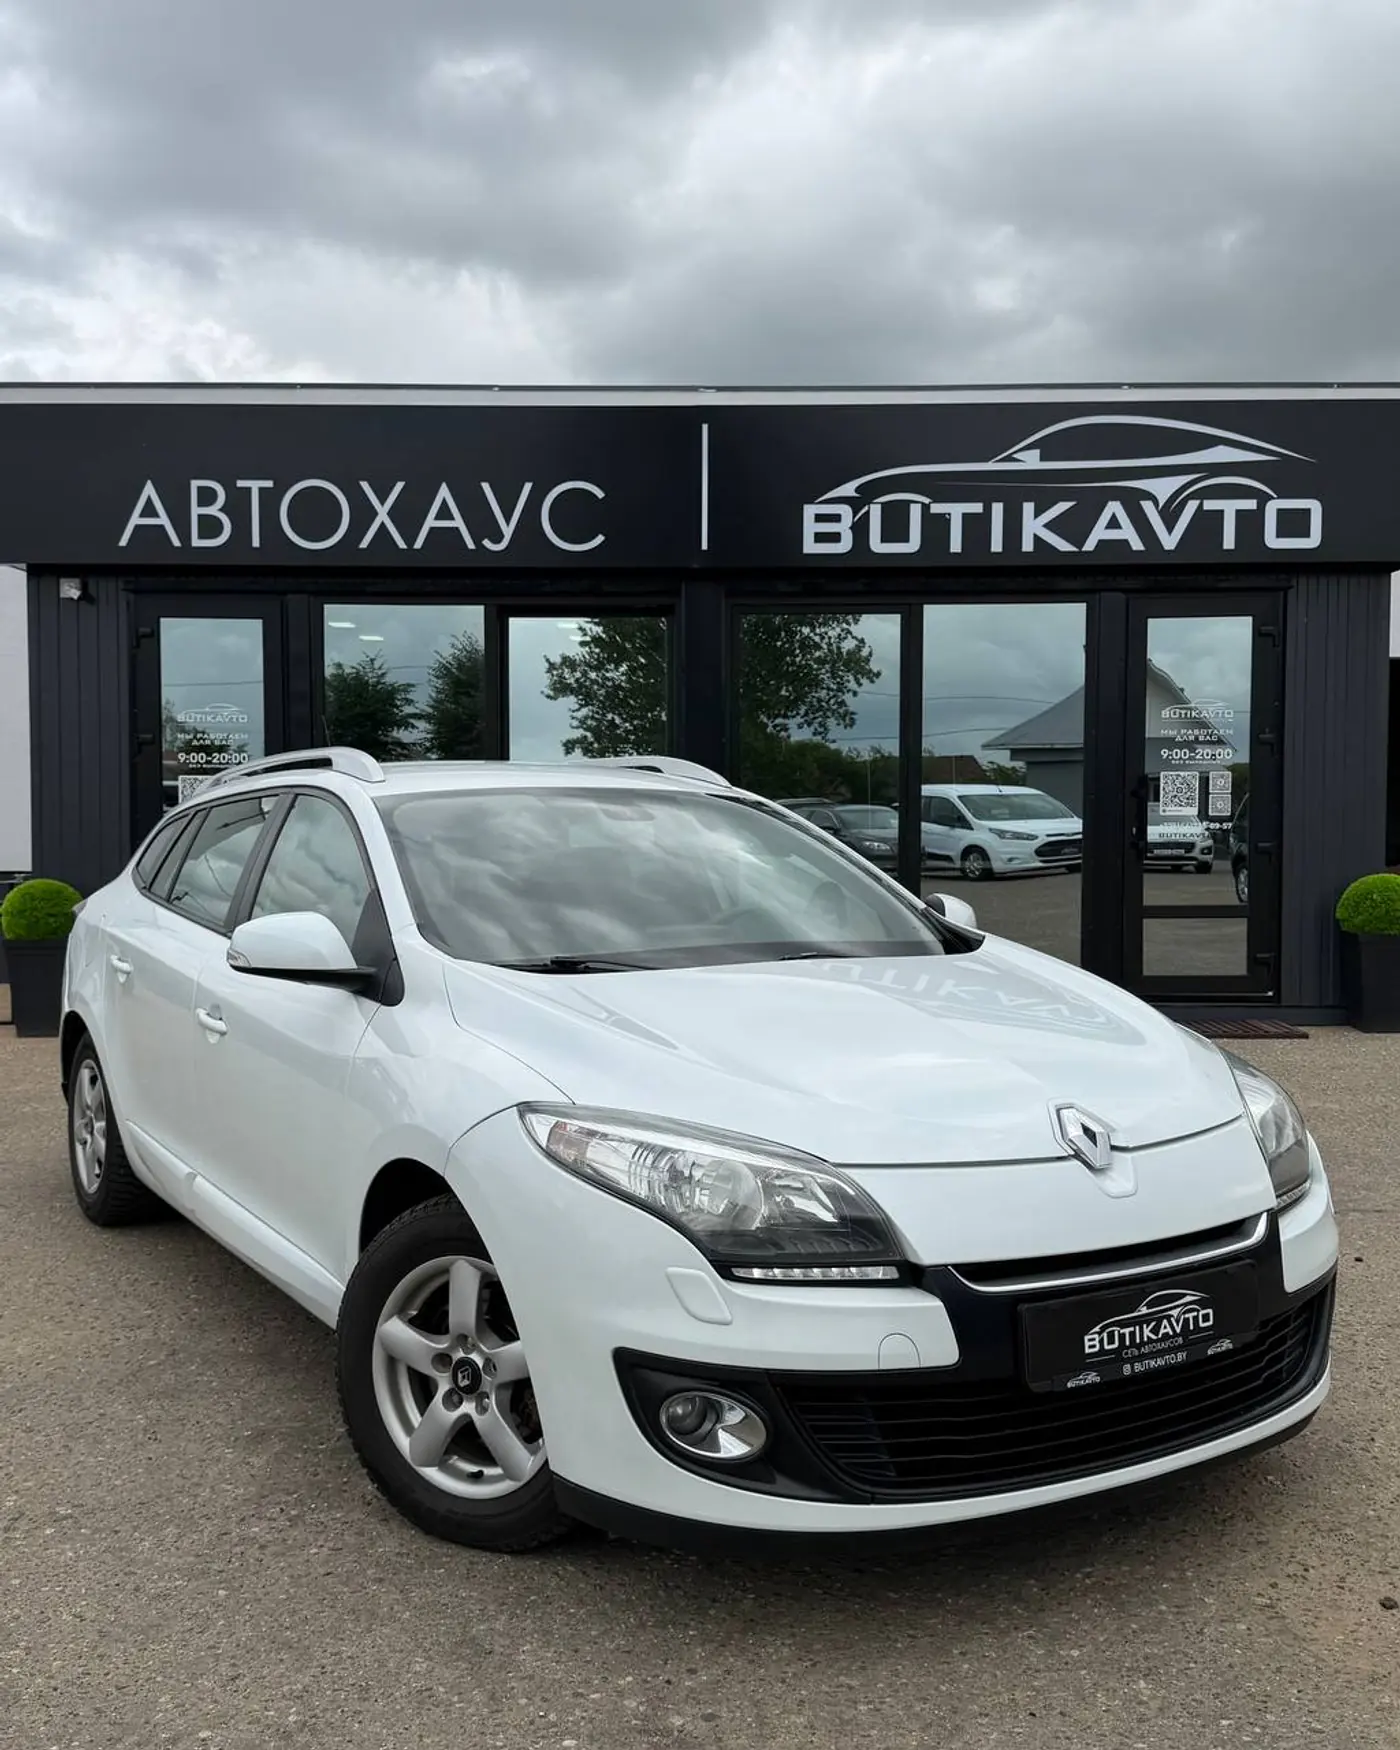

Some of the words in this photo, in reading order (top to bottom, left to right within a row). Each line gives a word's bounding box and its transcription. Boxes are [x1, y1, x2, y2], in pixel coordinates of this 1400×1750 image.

[118, 478, 606, 552] АВТОХАУС
[802, 498, 1323, 555] BUTIKAVTO
[1161, 709, 1234, 718] BUTIKAVTO
[177, 752, 249, 763] 9:00-20:00
[1160, 748, 1233, 759] 9:00-20:00
[1084, 1307, 1214, 1354] BUTIKAVTO
[1140, 1336, 1183, 1354] АВТОХАУСОВ
[1133, 1350, 1188, 1373] BUTIKAVTO.BY
